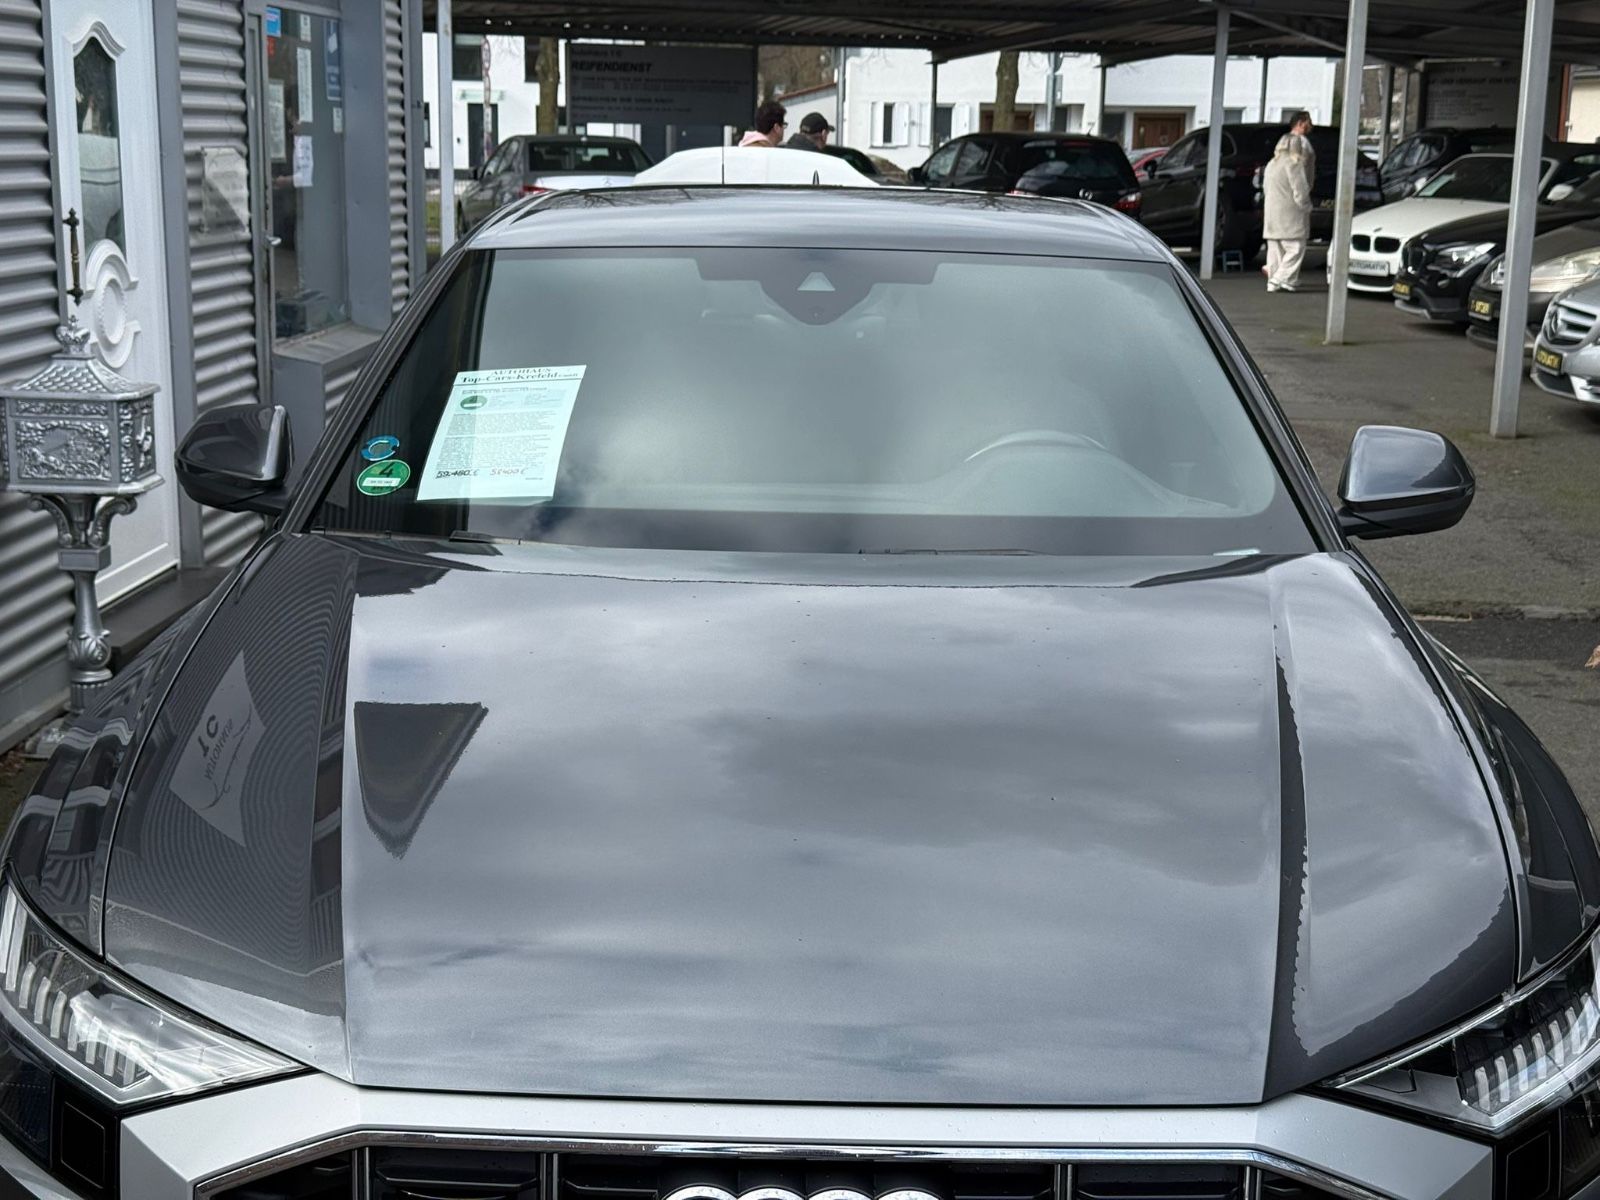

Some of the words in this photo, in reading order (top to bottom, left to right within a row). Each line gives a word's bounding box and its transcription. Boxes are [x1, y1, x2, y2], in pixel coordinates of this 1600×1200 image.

[571, 60, 652, 73] REIFENDIENST
[461, 369, 558, 384] Top-Cars-Krefeld
[491, 367, 552, 376] AUTOHAUS
[379, 461, 396, 478] 4
